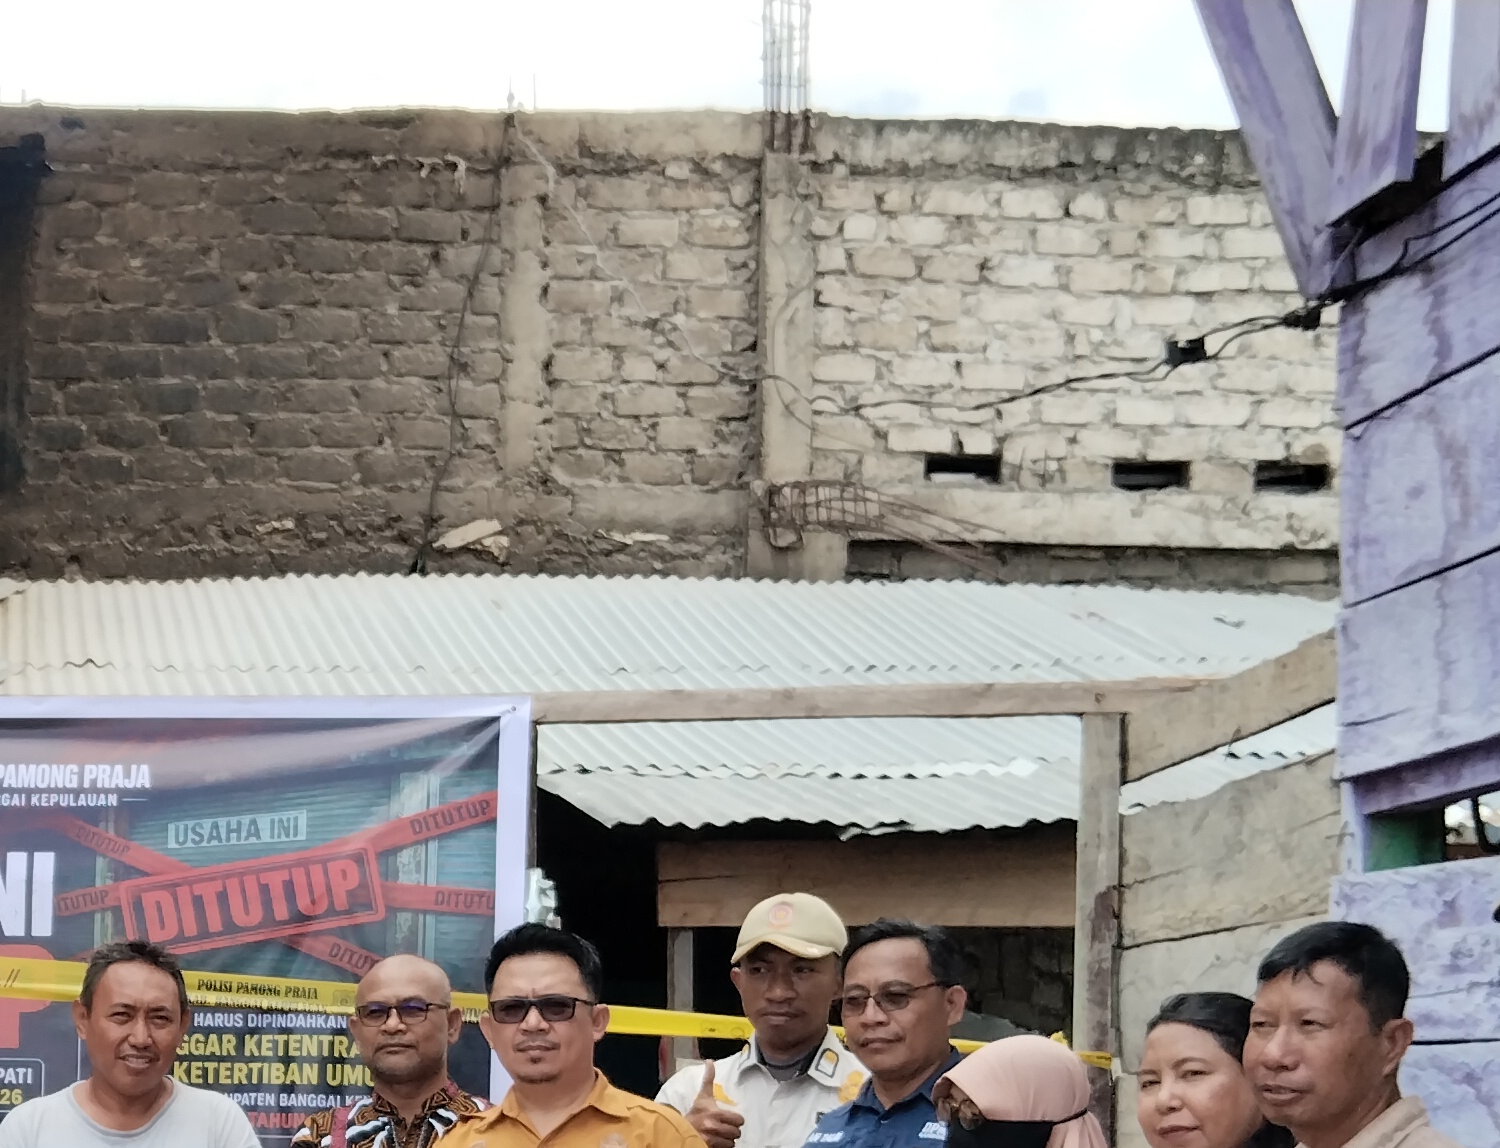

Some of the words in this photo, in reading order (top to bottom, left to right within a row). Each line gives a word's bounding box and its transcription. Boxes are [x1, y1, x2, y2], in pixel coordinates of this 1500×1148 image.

[83, 764, 151, 790] PRAJA
[31, 793, 118, 808] KEPULAUAN
[409, 799, 491, 836] DITUTUP
[174, 816, 262, 846] USAHA
[269, 815, 299, 840] INI
[56, 889, 109, 912] ITUTUP
[141, 858, 360, 943] DITUTUP
[434, 890, 495, 911] DITUTU
[196, 978, 233, 993] POLISI
[236, 981, 281, 997] PAMONG
[284, 985, 319, 1000] PRAJA
[193, 1012, 244, 1027] HARUS
[247, 1013, 347, 1029] DIPINDAHKAN
[175, 1033, 237, 1056] GGAR
[244, 1034, 361, 1058] KETENTRA
[173, 1061, 320, 1085] KETERTIBAN
[326, 1063, 375, 1087] UMU
[279, 1093, 340, 1108] BANGGAI
